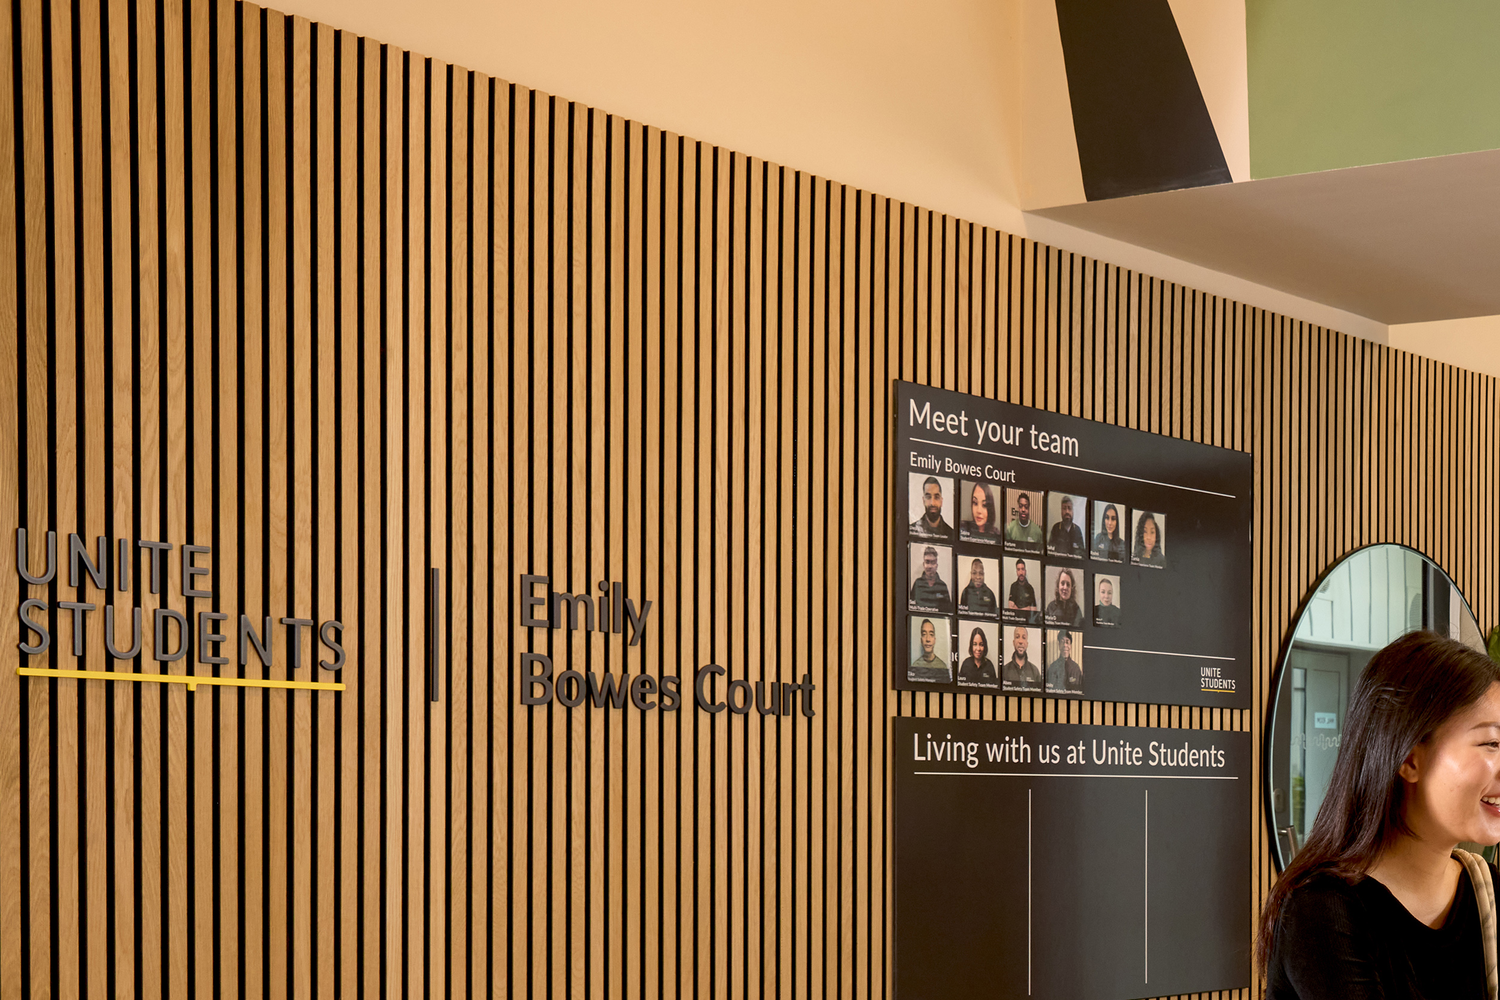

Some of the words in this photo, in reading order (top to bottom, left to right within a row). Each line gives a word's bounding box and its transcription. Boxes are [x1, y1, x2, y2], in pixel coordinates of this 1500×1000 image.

[909, 399, 969, 437] Meet
[975, 418, 1024, 447] your
[1029, 424, 1080, 457] team
[910, 451, 942, 473] Emily
[945, 457, 982, 478] Bowes
[985, 465, 1016, 483] Court
[15, 527, 212, 599] UNITE
[17, 598, 347, 672] STUDENTS
[520, 574, 653, 646] Emily
[520, 652, 681, 712] Bowes
[693, 664, 816, 718] Court
[1200, 666, 1221, 678] UNITE
[1200, 678, 1236, 690] STUDENTS
[913, 732, 979, 768] Living
[985, 735, 1032, 764] with
[1038, 742, 1060, 765] us
[1066, 739, 1086, 765] at
[1092, 739, 1143, 766] Unite
[1148, 741, 1225, 768] Students
